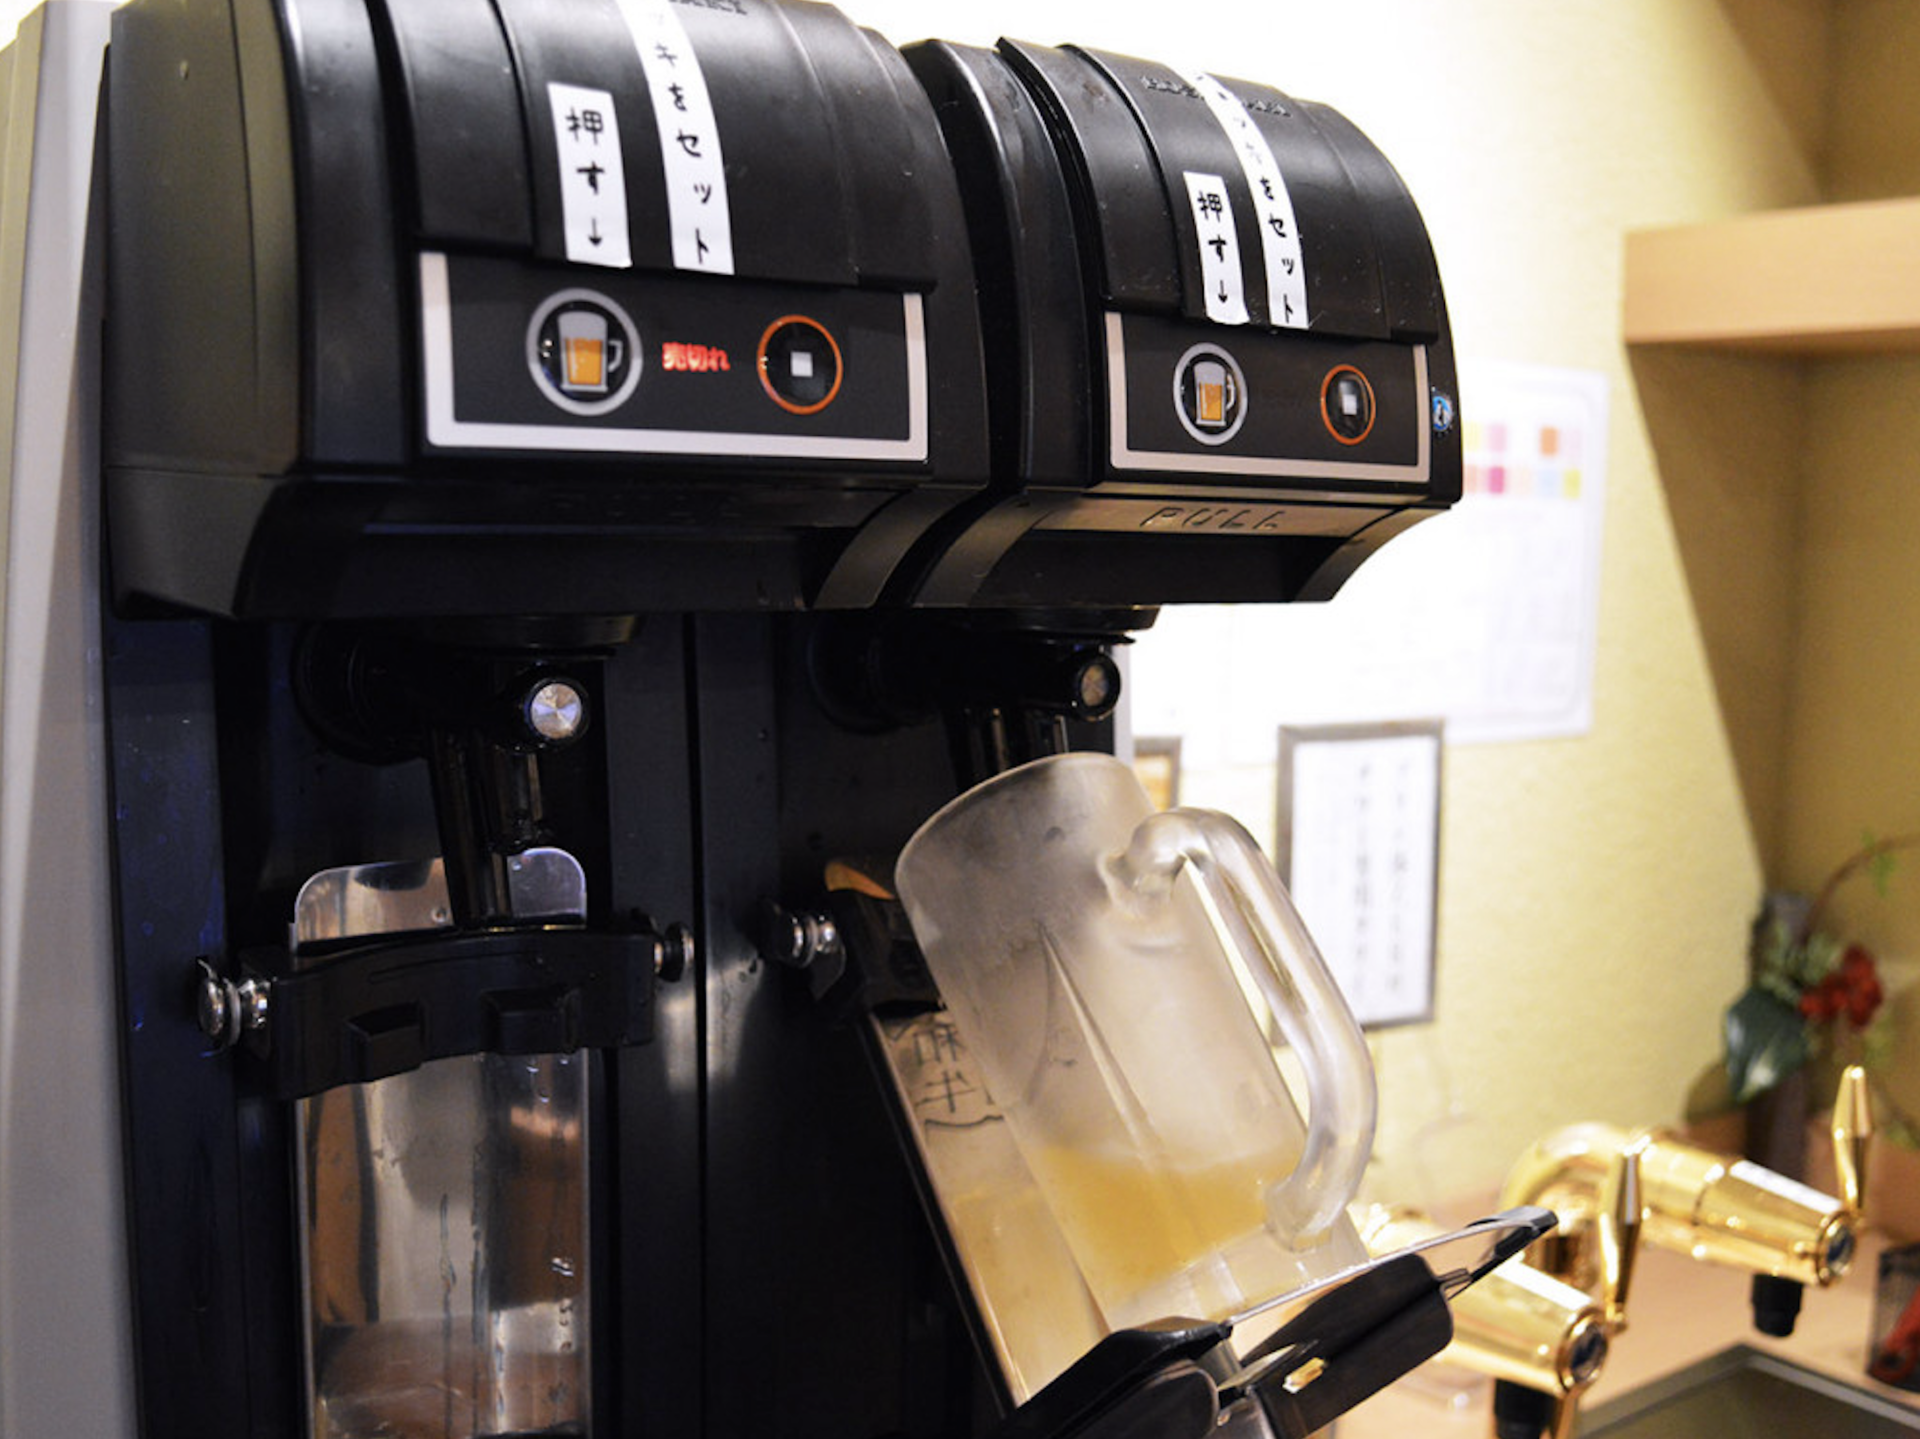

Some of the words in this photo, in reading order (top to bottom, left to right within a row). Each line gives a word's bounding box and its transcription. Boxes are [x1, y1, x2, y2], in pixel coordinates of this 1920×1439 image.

[564, 106, 605, 196] 押す
[1196, 191, 1227, 263] 押す
[661, 341, 731, 372] 売切れ
[1139, 506, 1286, 530] PULL
